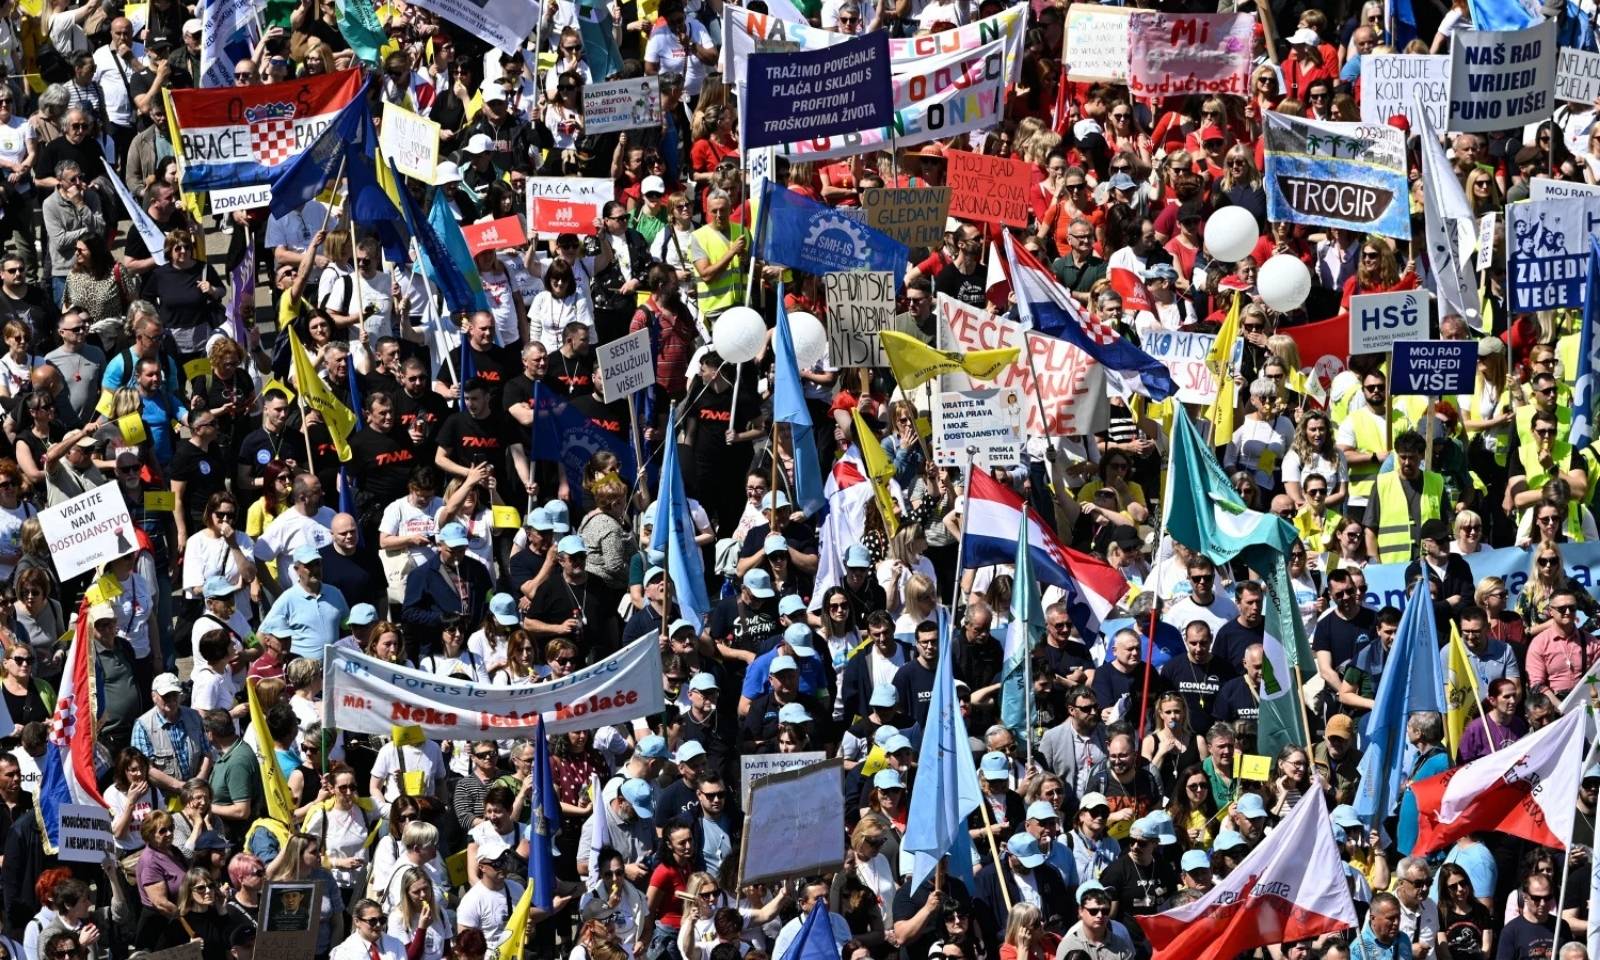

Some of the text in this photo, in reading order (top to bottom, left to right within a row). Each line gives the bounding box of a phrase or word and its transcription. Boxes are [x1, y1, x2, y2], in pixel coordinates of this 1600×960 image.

[1170, 18, 1210, 47] Mi
[765, 47, 876, 79] TRAŽ!MO POVEĆANJE
[1465, 40, 1542, 66] NAŠ RAD
[1375, 56, 1431, 80] POŠTUJTE
[772, 67, 872, 97] PLAĆA U SKLADU S
[1131, 72, 1249, 95] budućnost!
[1376, 82, 1404, 101] KOJI
[1468, 68, 1537, 93] VRIJEDI
[792, 90, 856, 113] PROFITOM I
[1451, 89, 1546, 121] PUNO VIŠE!
[764, 103, 876, 133] TROŠKOVIMA ŽIVOTA
[183, 128, 249, 161] BRAĆE
[955, 154, 1015, 179] MOJ RAD
[214, 191, 269, 210] ZDRAVLJE
[532, 183, 571, 196] PLAĆA
[867, 188, 946, 207] O MIROVINI
[951, 174, 1026, 205] SIVA ZONA
[1287, 180, 1376, 219] TROGIR
[1545, 186, 1593, 200] MOJ RAD
[877, 207, 939, 226] GLEDAM
[1003, 202, 1029, 223] RADU
[818, 236, 853, 257] SMH-IS
[1516, 281, 1568, 309] VEĆE
[828, 304, 849, 334] NE
[1361, 304, 1418, 332] HSt
[609, 337, 639, 360] SESTRE
[1145, 332, 1172, 357] AKO
[1174, 332, 1193, 357] MI
[1410, 347, 1461, 357] MOJ RAD
[604, 351, 650, 380] ZASLUŽUJU
[1409, 359, 1460, 371] VRIJEDI
[616, 371, 644, 394] VIŠE!!!
[1409, 369, 1459, 391] V!ŠE
[942, 400, 975, 411] VRATITE
[942, 409, 993, 421] MOJA PRAVA
[943, 421, 969, 434] I MOJE
[944, 428, 1010, 442] DOSTOJANSTVO!
[60, 492, 104, 519] VRATITE
[70, 511, 97, 531] NAM
[49, 512, 130, 555] DOSTOJANSTVO
[344, 659, 371, 678] AP:
[343, 694, 373, 712] MA:
[389, 700, 458, 728] Neka
[554, 687, 638, 723] kolače
[745, 760, 770, 770] DAJTE
